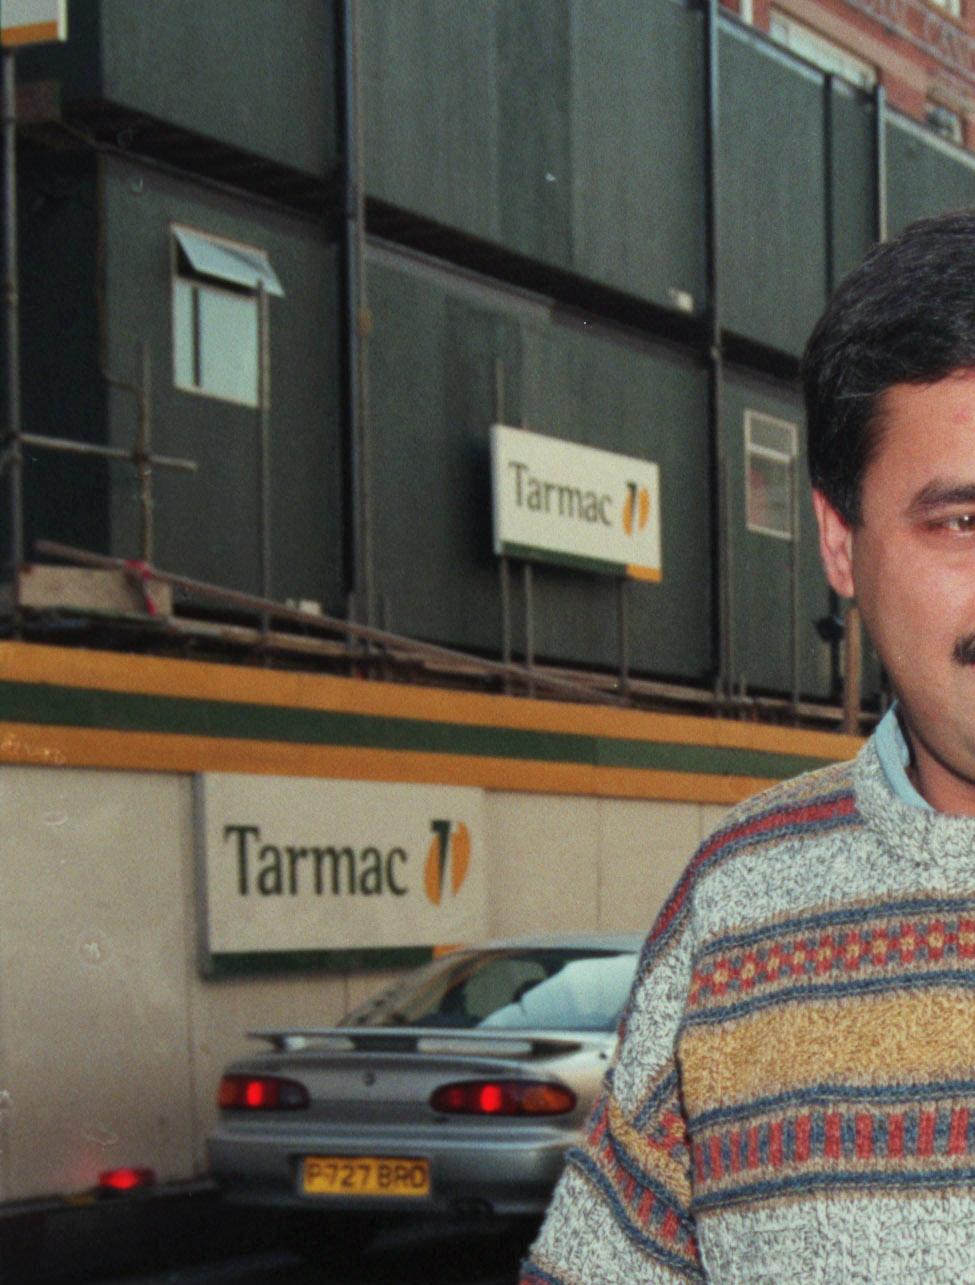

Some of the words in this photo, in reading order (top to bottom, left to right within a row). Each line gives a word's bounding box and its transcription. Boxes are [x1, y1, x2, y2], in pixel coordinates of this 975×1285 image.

[508, 460, 613, 527] Tarmac
[223, 824, 409, 896] Tarmac
[307, 1163, 371, 1188] P727
